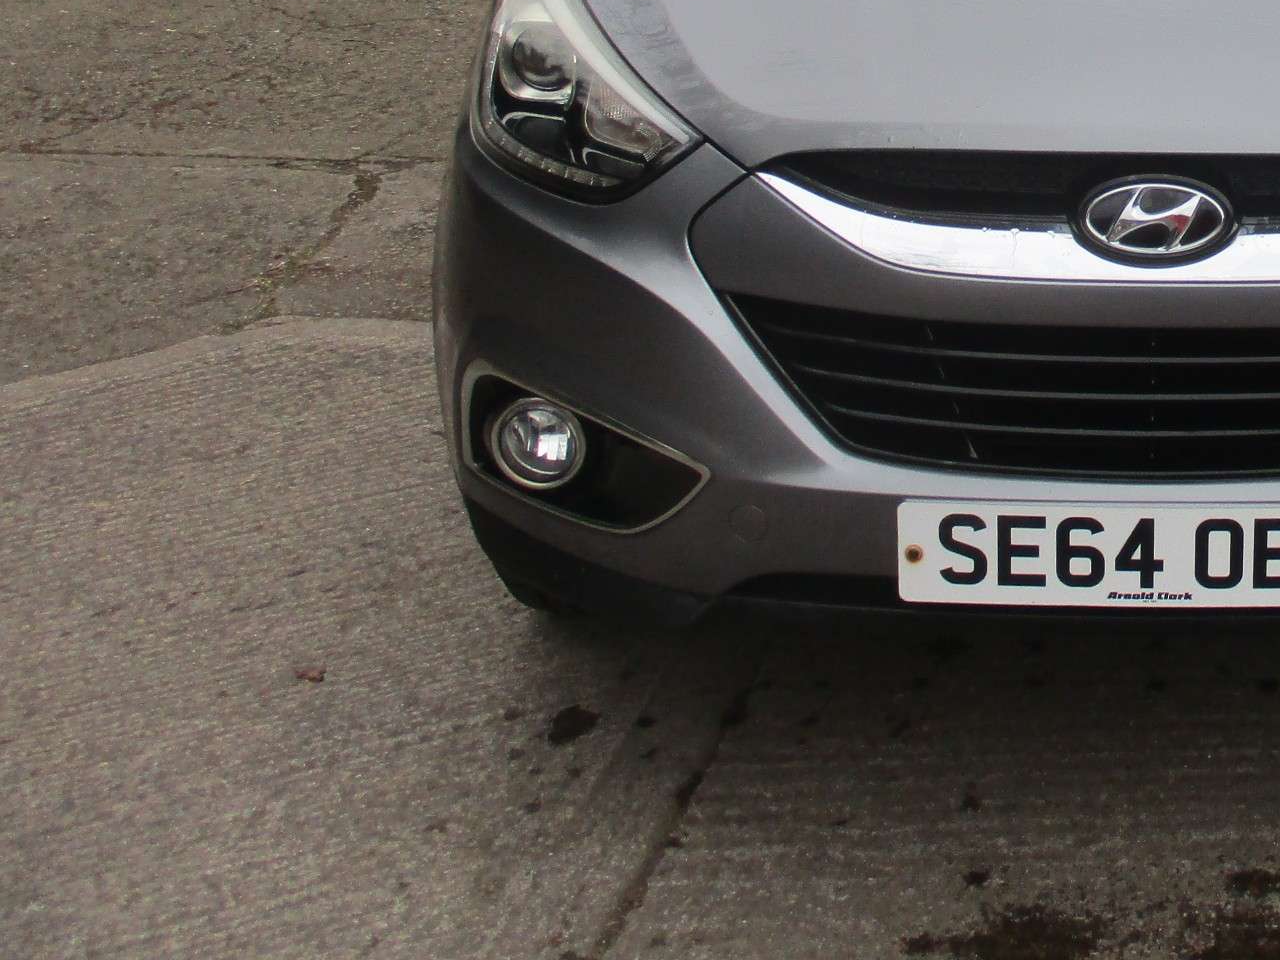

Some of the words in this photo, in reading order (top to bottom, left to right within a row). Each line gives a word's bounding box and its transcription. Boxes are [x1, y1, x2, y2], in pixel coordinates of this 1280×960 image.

[937, 513, 1165, 590] SE64
[1107, 591, 1155, 601] Arnold
[1157, 591, 1193, 601] Clark
